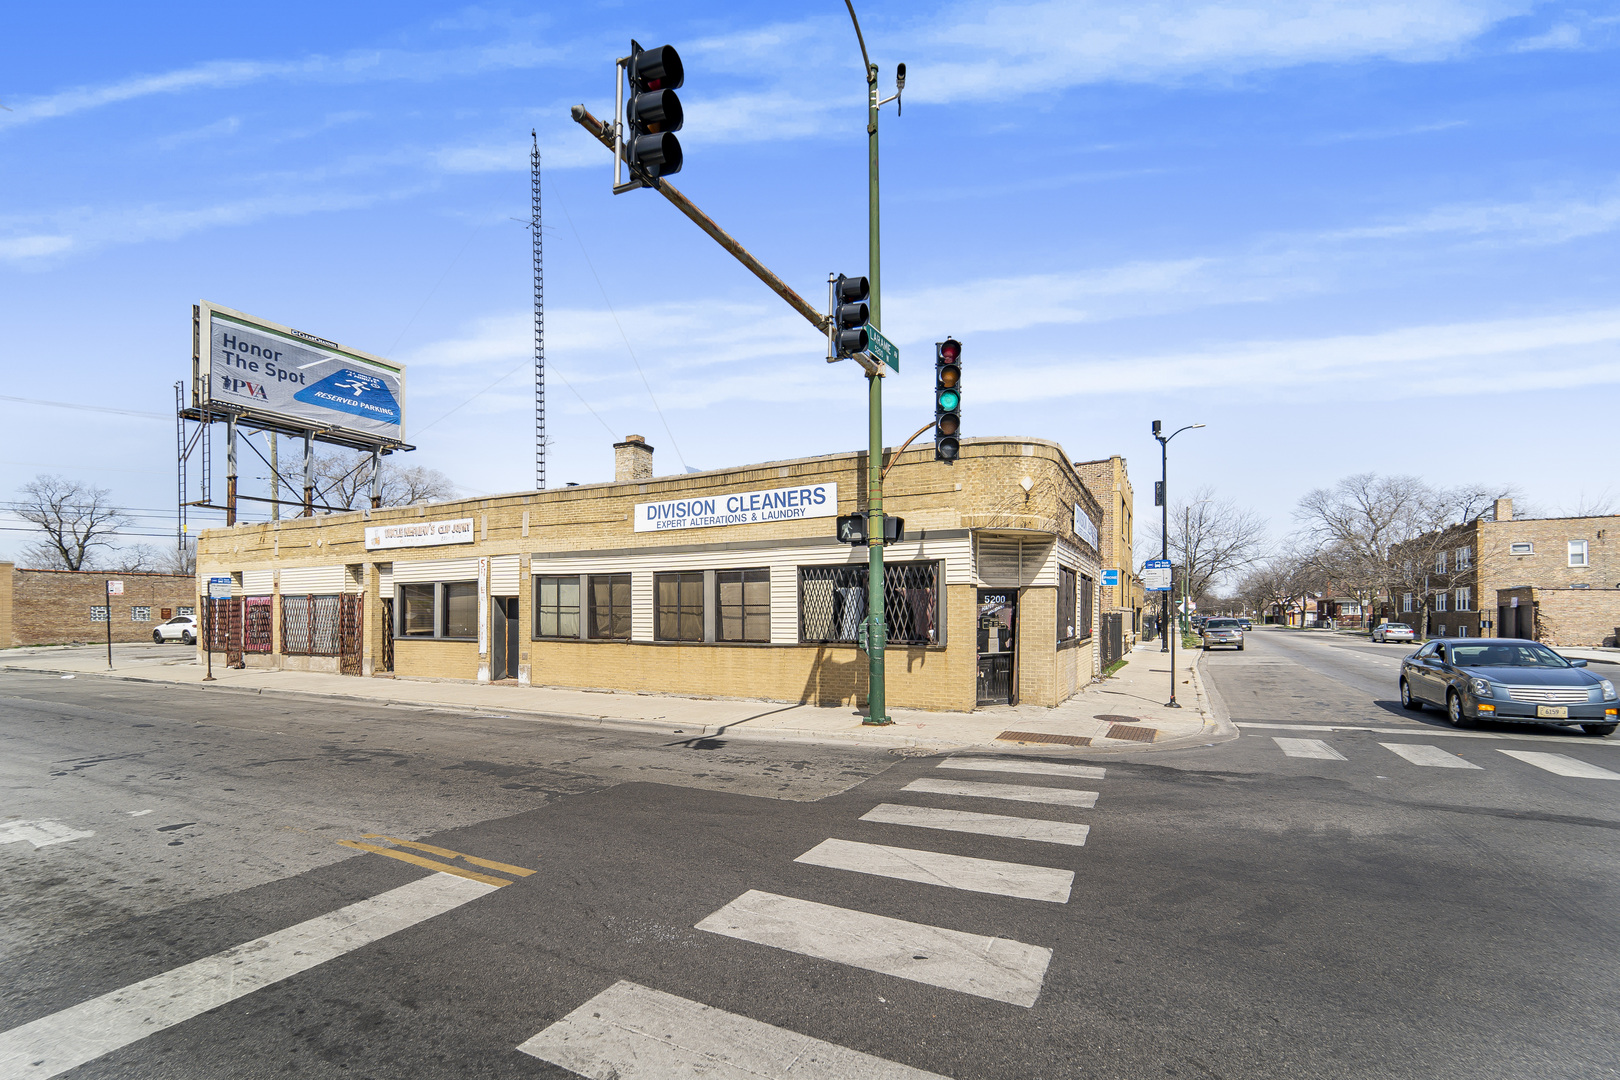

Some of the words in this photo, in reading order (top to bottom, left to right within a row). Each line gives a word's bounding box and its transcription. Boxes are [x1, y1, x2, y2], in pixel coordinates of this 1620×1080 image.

[224, 333, 282, 362] Honor
[222, 350, 259, 372] The
[265, 362, 306, 385] Spot
[232, 378, 268, 400] PVA
[314, 391, 358, 407] RESERVED
[360, 402, 394, 416] PARKING
[647, 499, 715, 520] DIVISION
[726, 487, 826, 514] CLEANERS
[656, 519, 687, 529] EXPERT
[690, 513, 747, 527] ALTERATIONS
[751, 513, 757, 521] &
[762, 508, 806, 520] LAUNDRY
[984, 595, 1006, 604] 5200
